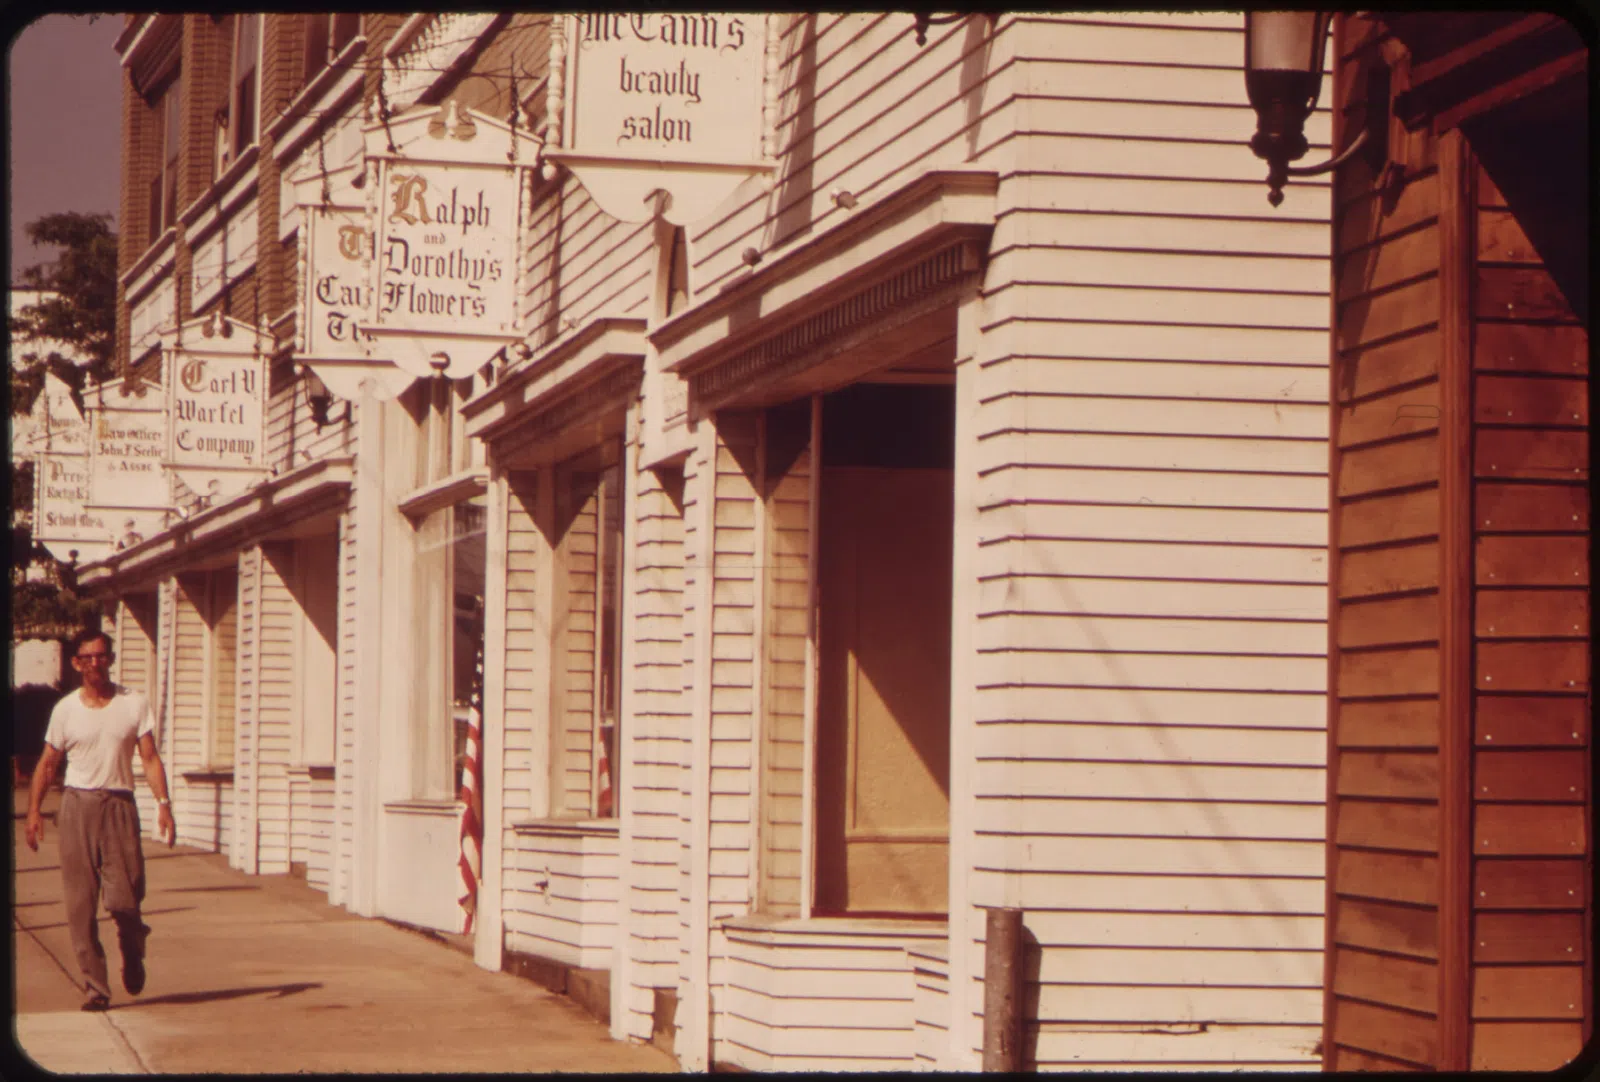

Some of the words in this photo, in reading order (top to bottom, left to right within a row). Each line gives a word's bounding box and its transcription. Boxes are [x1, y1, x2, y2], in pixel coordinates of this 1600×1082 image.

[582, 13, 745, 56] McCanns
[621, 55, 701, 107] beauty
[617, 103, 692, 147] salon
[388, 174, 490, 235] Ralph
[423, 233, 447, 246] and
[382, 235, 503, 290] Dorothy's
[382, 281, 487, 317] Flowers
[180, 358, 236, 394] Carl
[176, 399, 244, 425] Warfel
[176, 430, 256, 465] Company
